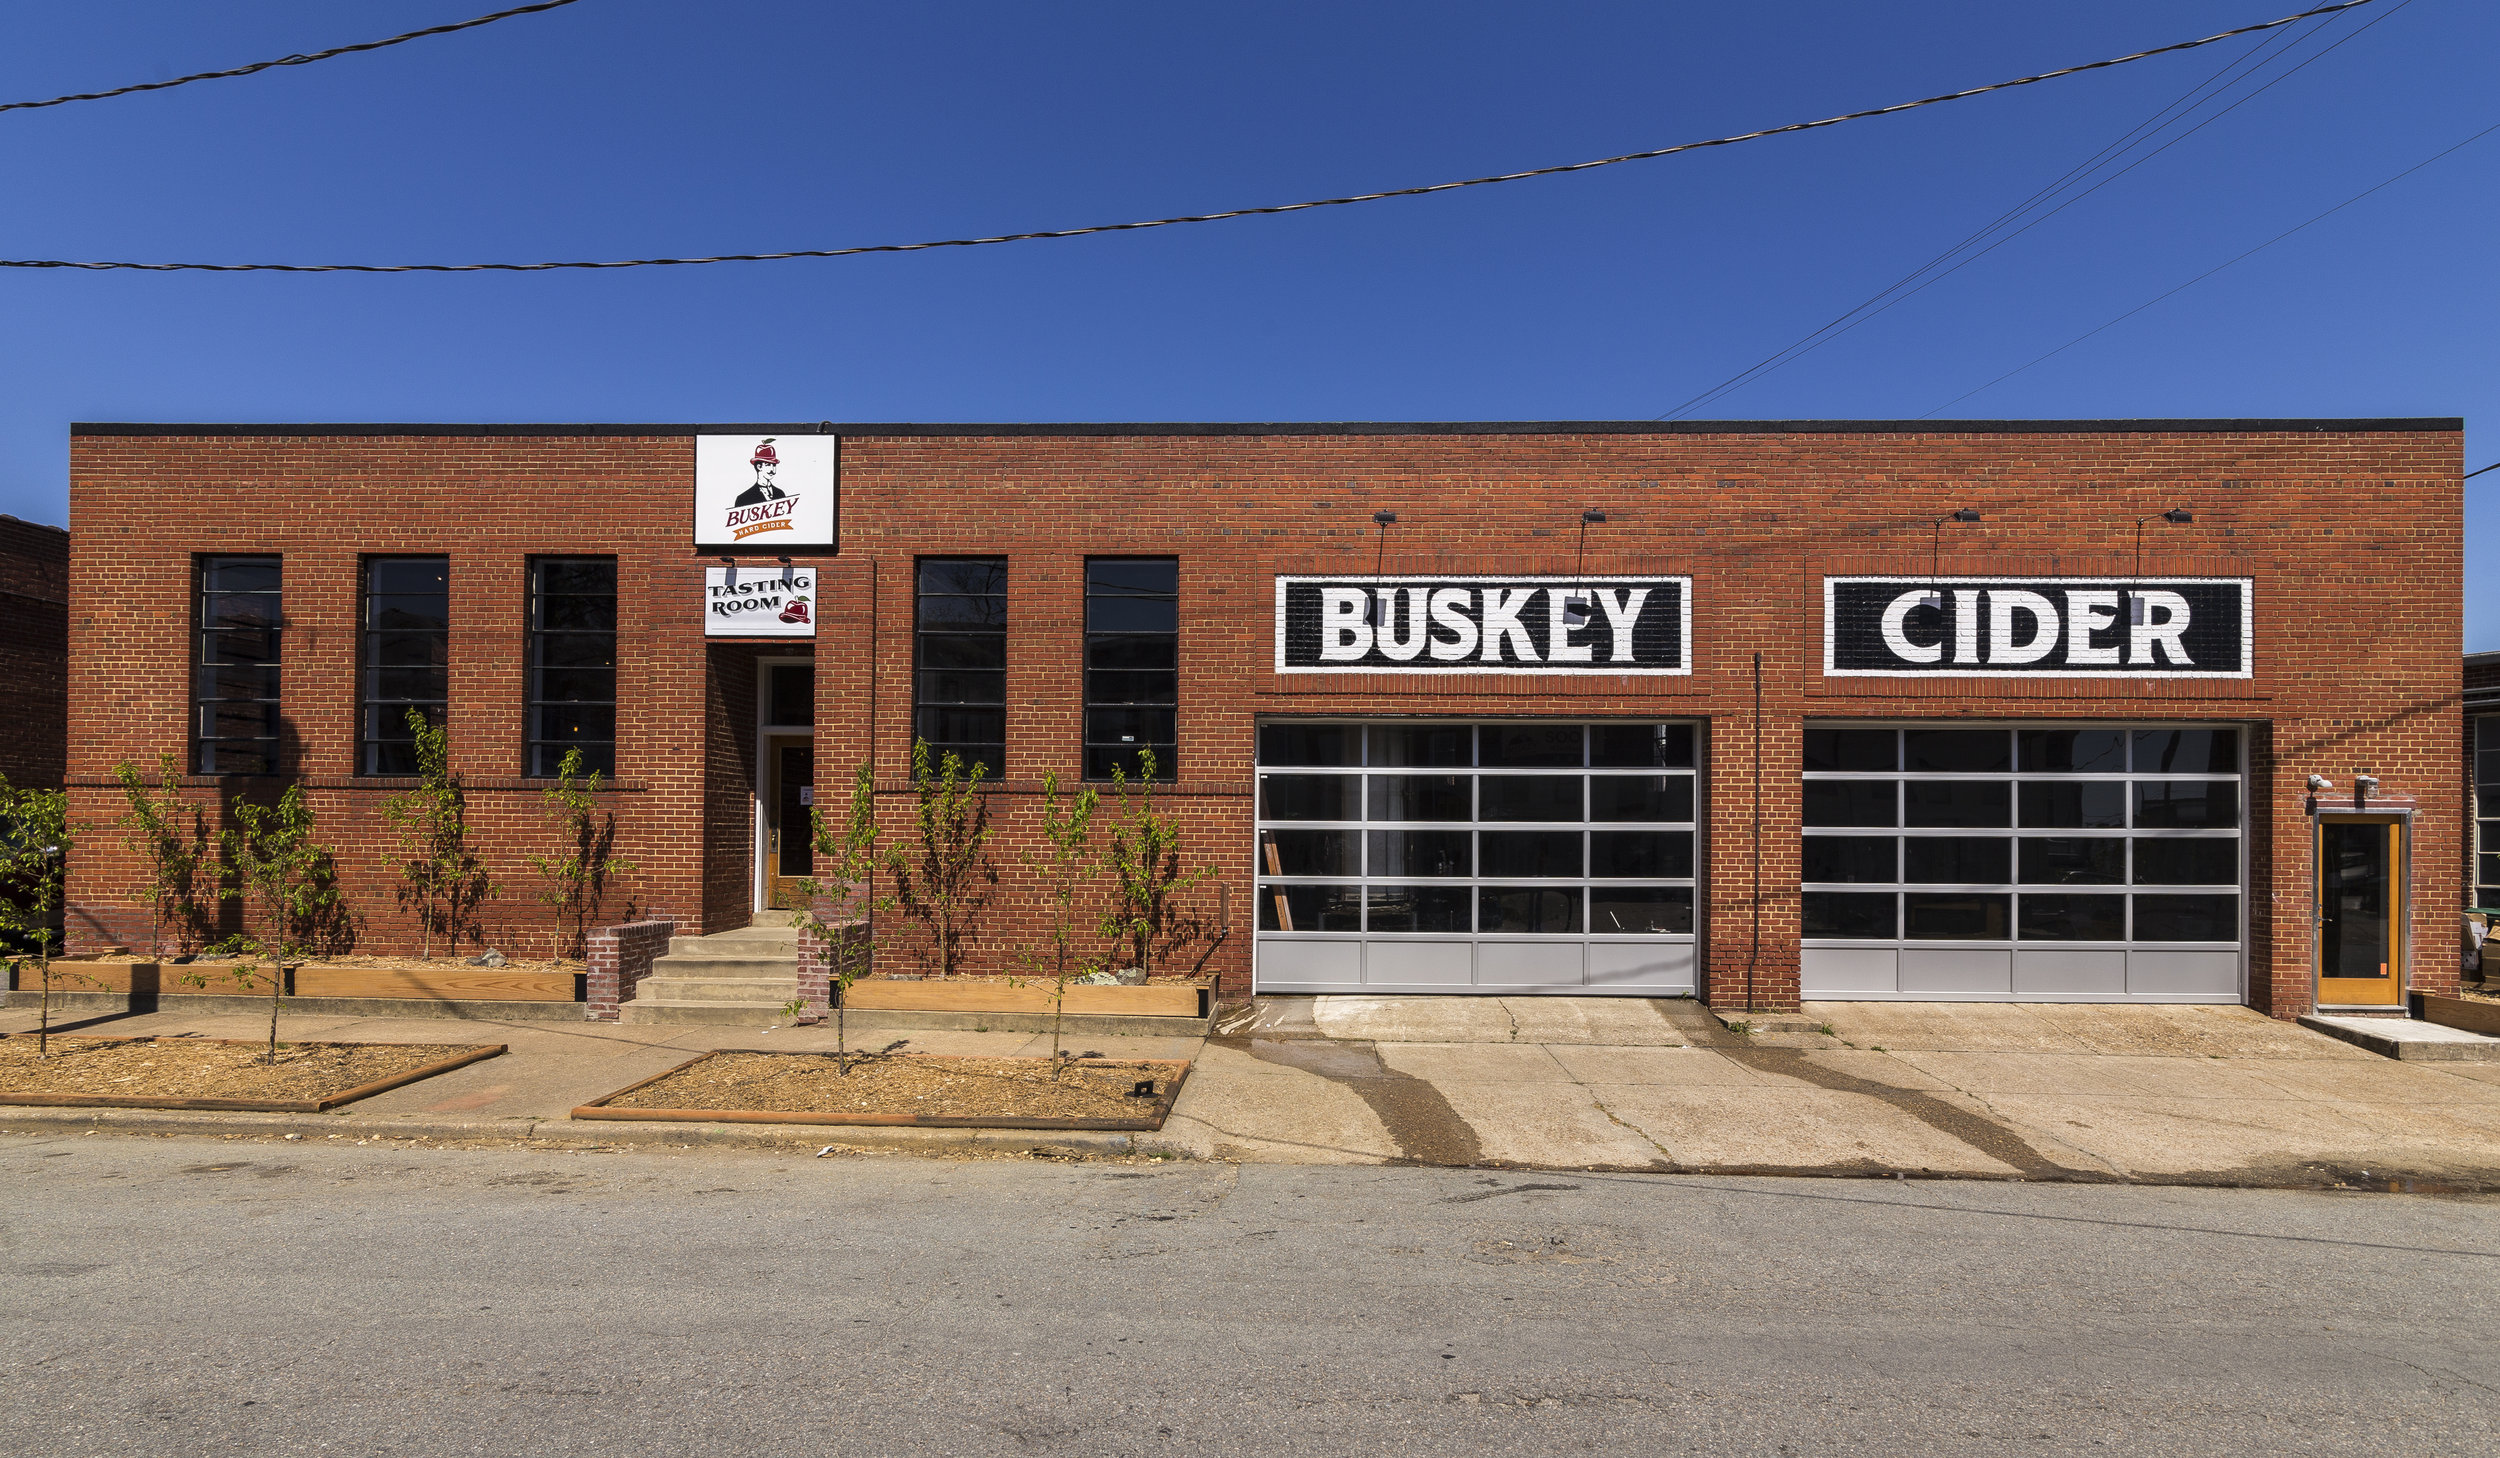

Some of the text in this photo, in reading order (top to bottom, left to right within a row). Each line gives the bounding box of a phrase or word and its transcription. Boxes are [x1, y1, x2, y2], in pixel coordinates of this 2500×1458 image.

[725, 497, 799, 527] BUSKEY
[738, 521, 786, 536] HARD CIDER
[708, 576, 811, 598] TASTING
[712, 596, 781, 618] ROOM
[1319, 587, 1653, 662] BUSKEY
[1880, 589, 2196, 665] CIDER
